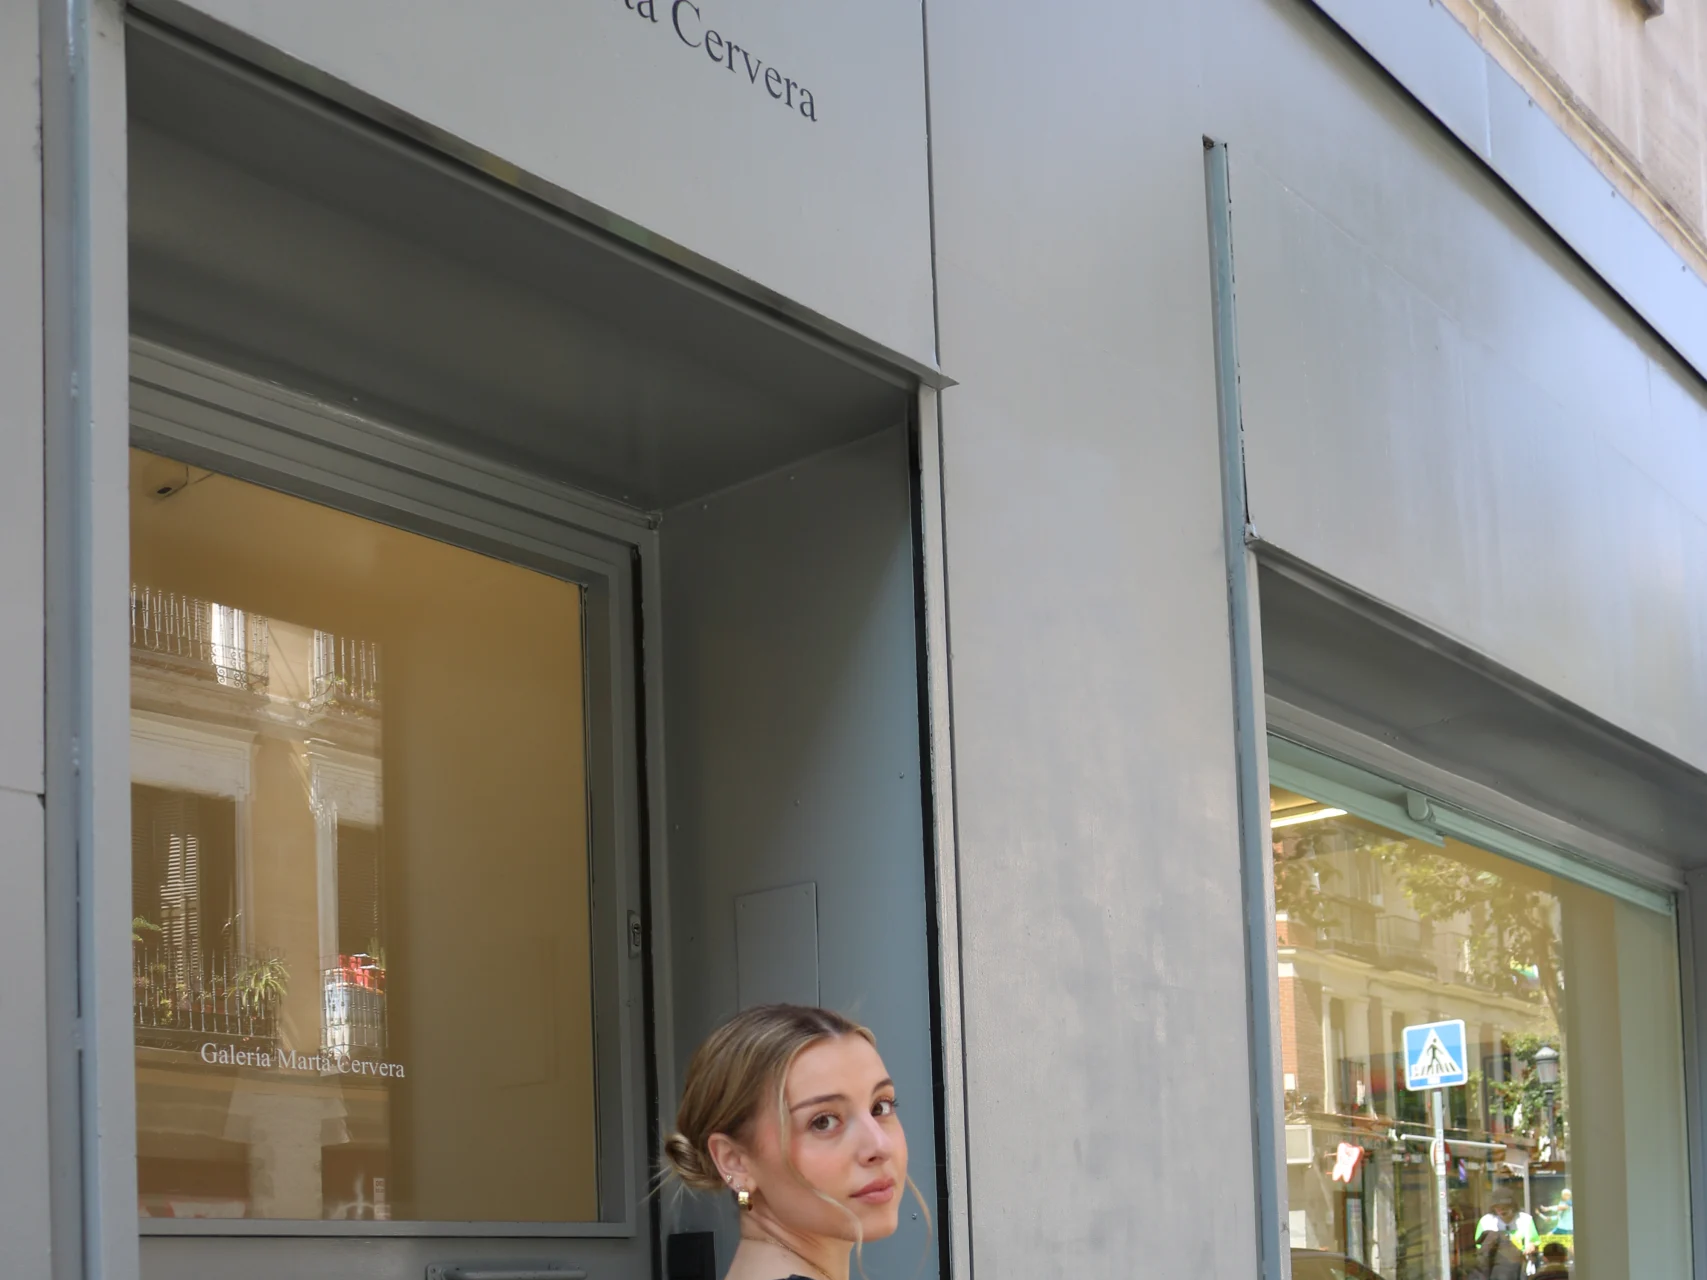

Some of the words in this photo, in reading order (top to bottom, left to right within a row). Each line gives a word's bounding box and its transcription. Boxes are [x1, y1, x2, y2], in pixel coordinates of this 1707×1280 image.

[671, 0, 818, 122] Cervera
[201, 1042, 271, 1068] Galería
[278, 1049, 331, 1072] Marta
[337, 1054, 406, 1079] Cervera
